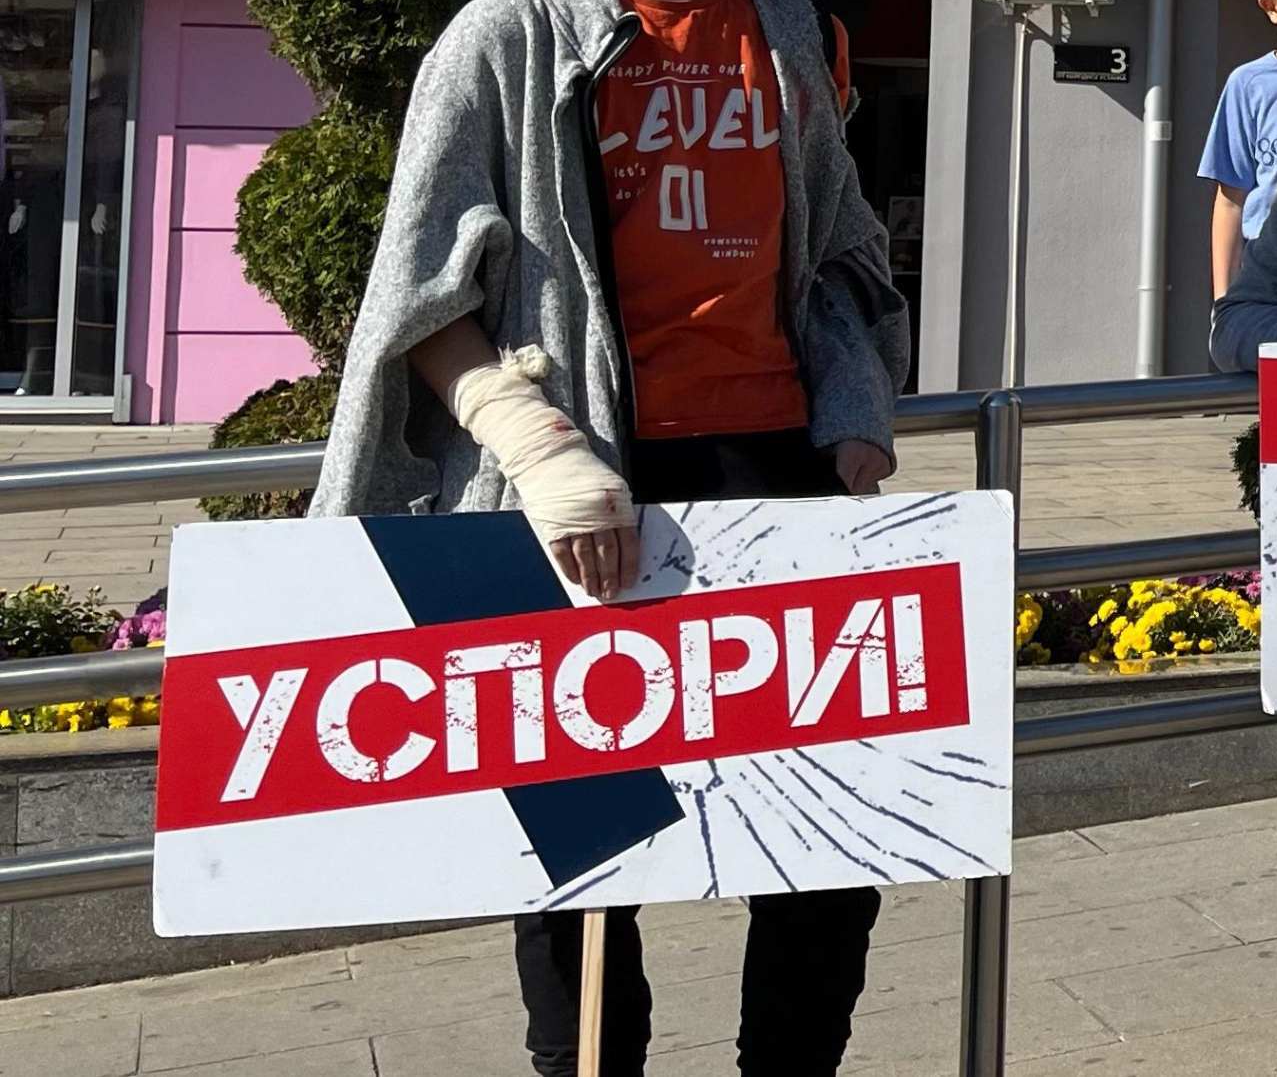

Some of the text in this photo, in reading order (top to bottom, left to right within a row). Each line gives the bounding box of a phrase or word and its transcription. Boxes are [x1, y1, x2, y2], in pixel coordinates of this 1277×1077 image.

[661, 59, 710, 74] PLAYER
[719, 63, 745, 75] ONE
[1110, 48, 1127, 74] 3
[593, 85, 780, 155] LEVEL
[217, 593, 927, 803] УСПОРИ!
